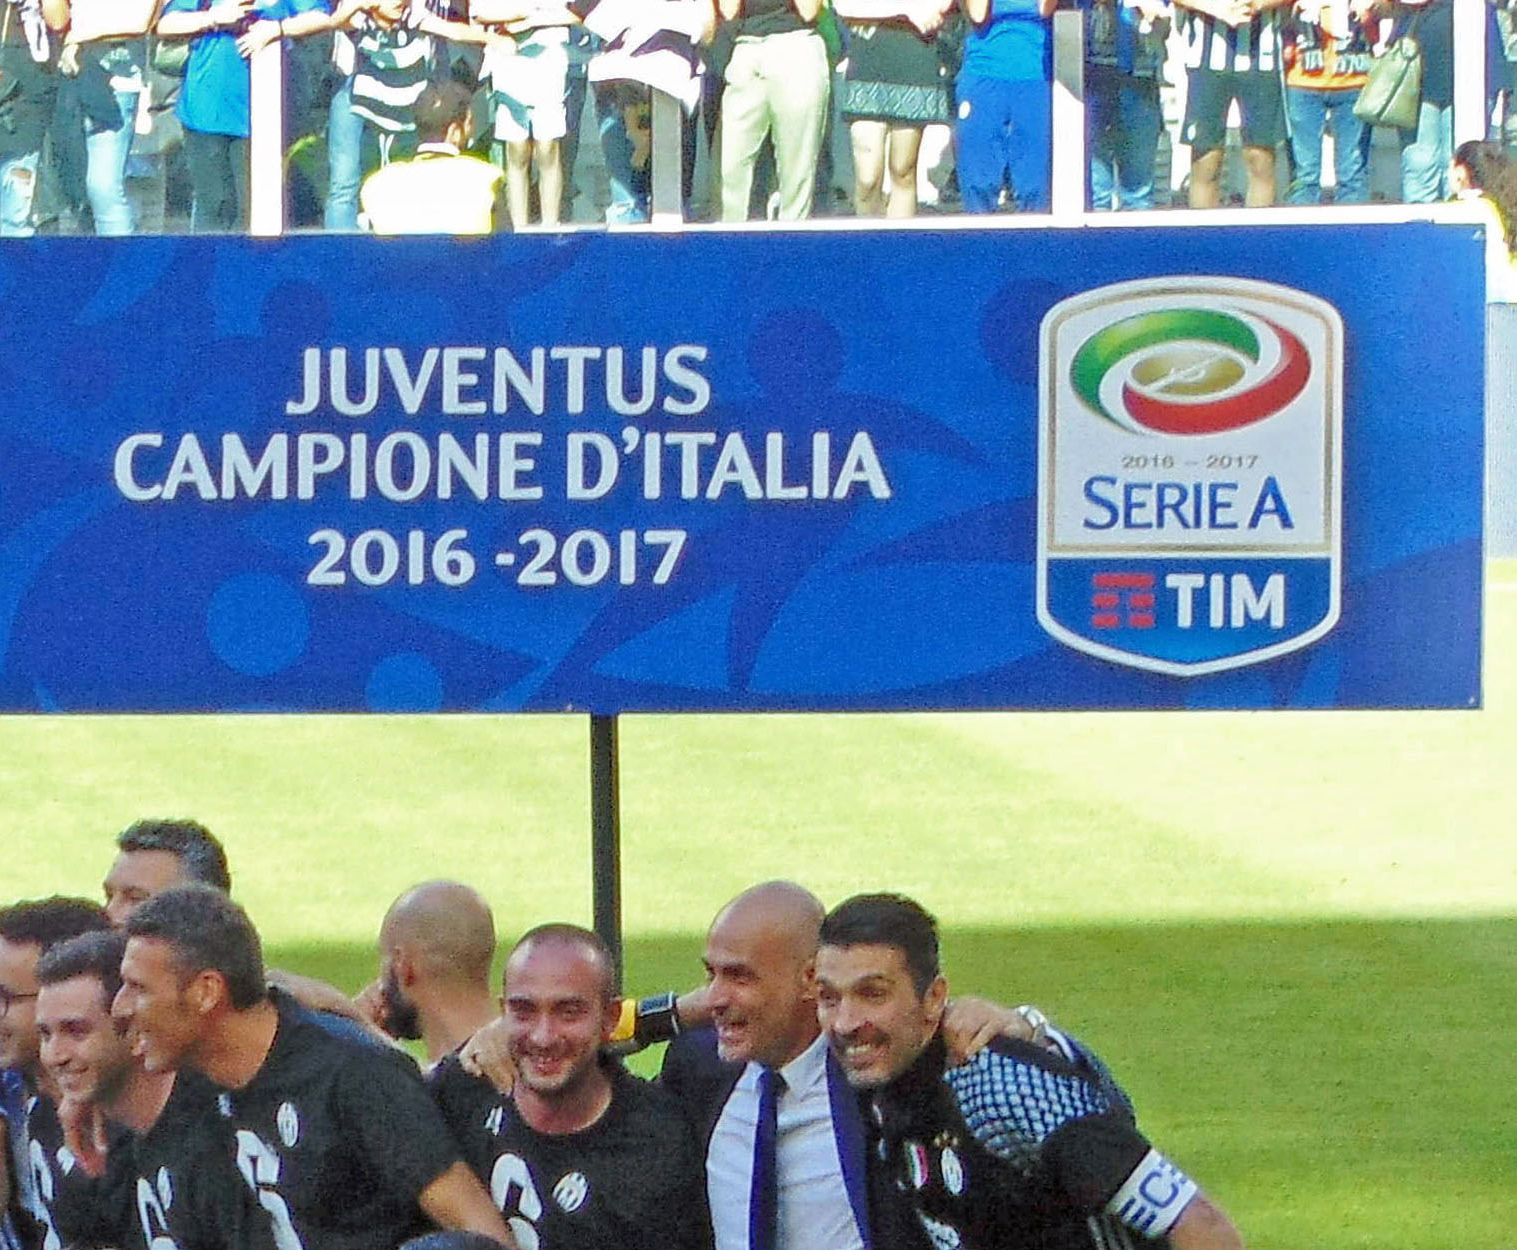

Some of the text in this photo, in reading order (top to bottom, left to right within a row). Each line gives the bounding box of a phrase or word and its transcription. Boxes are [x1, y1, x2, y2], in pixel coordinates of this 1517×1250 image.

[287, 345, 710, 416] JUVENTUS
[114, 432, 543, 501] CAMPIONE
[1121, 454, 1175, 469] 2016
[1206, 454, 1259, 469] 2017
[1083, 474, 1295, 530] SERIE A
[307, 529, 476, 585] 2016
[1166, 573, 1285, 628] TIM
